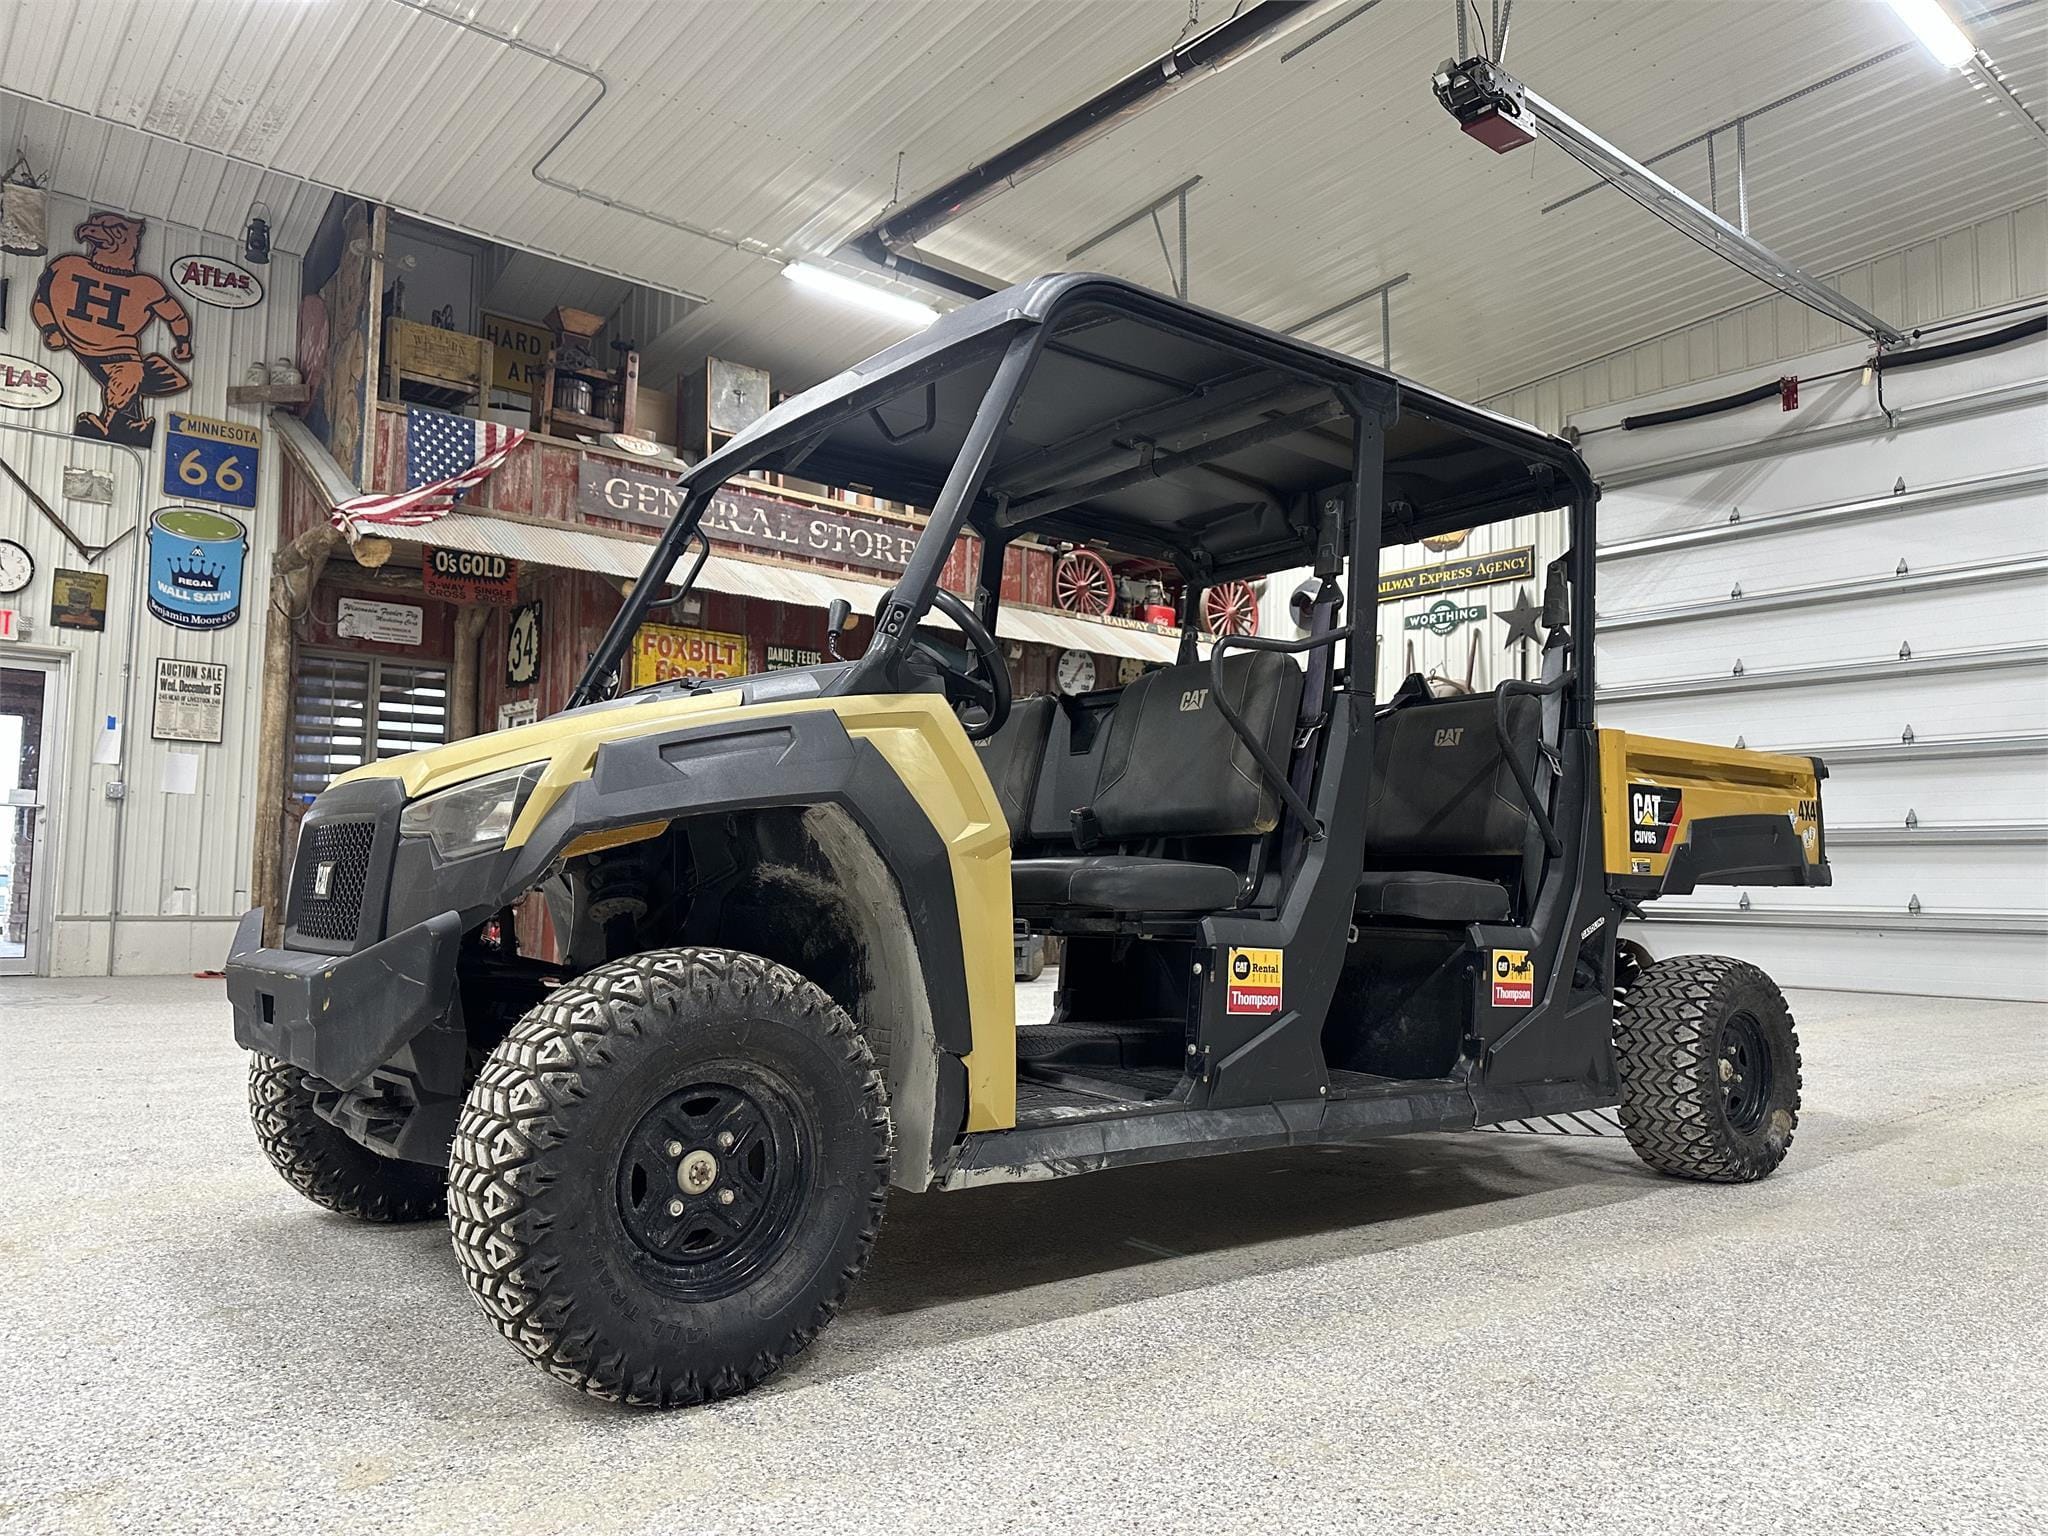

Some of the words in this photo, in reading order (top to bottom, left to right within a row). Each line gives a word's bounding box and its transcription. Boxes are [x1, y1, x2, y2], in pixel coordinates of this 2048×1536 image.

[180, 261, 251, 290] ATLAS
[66, 274, 131, 331] H
[487, 325, 541, 355] HARD
[0, 363, 48, 387] LAS
[187, 419, 258, 443] MINNESOTA
[178, 449, 244, 492] 66
[808, 520, 916, 564] STORE
[435, 551, 457, 573] O's
[459, 553, 506, 578] GOLD
[1378, 577, 1416, 593] AILWAY
[1419, 566, 1472, 586] EXPRESS
[1476, 556, 1527, 574] AGENCY
[157, 580, 190, 601] WALL
[193, 590, 232, 602] SATIN
[178, 577, 214, 588] REGAL
[474, 586, 513, 597] SINGLE
[428, 588, 466, 600] CROSS
[151, 599, 189, 623] Benjamin
[190, 614, 221, 625] Moore
[1409, 608, 1479, 626] WORTHING
[1103, 615, 1149, 631] RAILWAY
[512, 621, 533, 670] 34
[643, 633, 738, 665] FOXBILT
[797, 650, 822, 665] FEEDS
[160, 662, 198, 679] AUCTION
[201, 666, 223, 681] SALE
[160, 677, 177, 692] Wed.
[179, 679, 212, 695] December
[213, 683, 221, 696] 15
[1180, 689, 1208, 711] CAT
[1435, 727, 1464, 747] CAT
[1633, 792, 1661, 826] CAT
[1798, 800, 1816, 821] 4X4
[1634, 829, 1656, 844] CUV85
[1235, 961, 1248, 973] CAT
[1252, 963, 1279, 974] Rental
[1498, 962, 1508, 972] CAT
[1231, 990, 1279, 1009] Thompson
[1495, 987, 1531, 1002] Thompson
